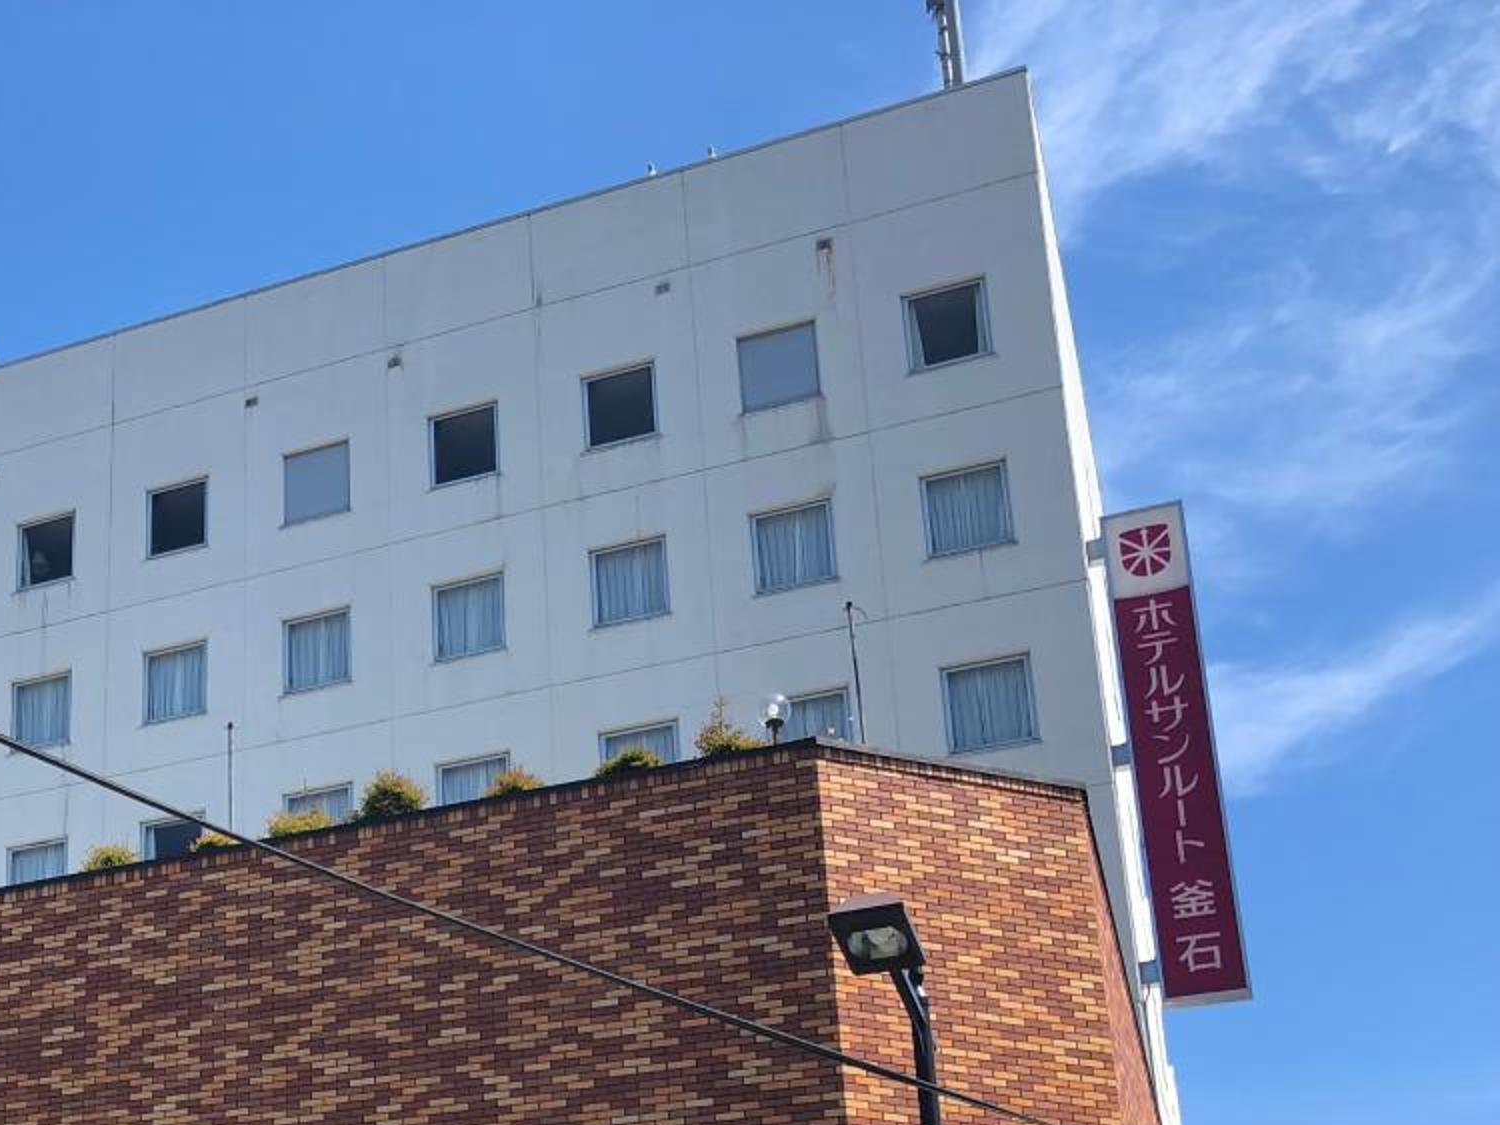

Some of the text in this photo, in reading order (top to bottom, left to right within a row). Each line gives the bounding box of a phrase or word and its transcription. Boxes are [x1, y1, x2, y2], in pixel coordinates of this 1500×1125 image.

[1132, 599, 1224, 973] ホテルサンルート 釜石
